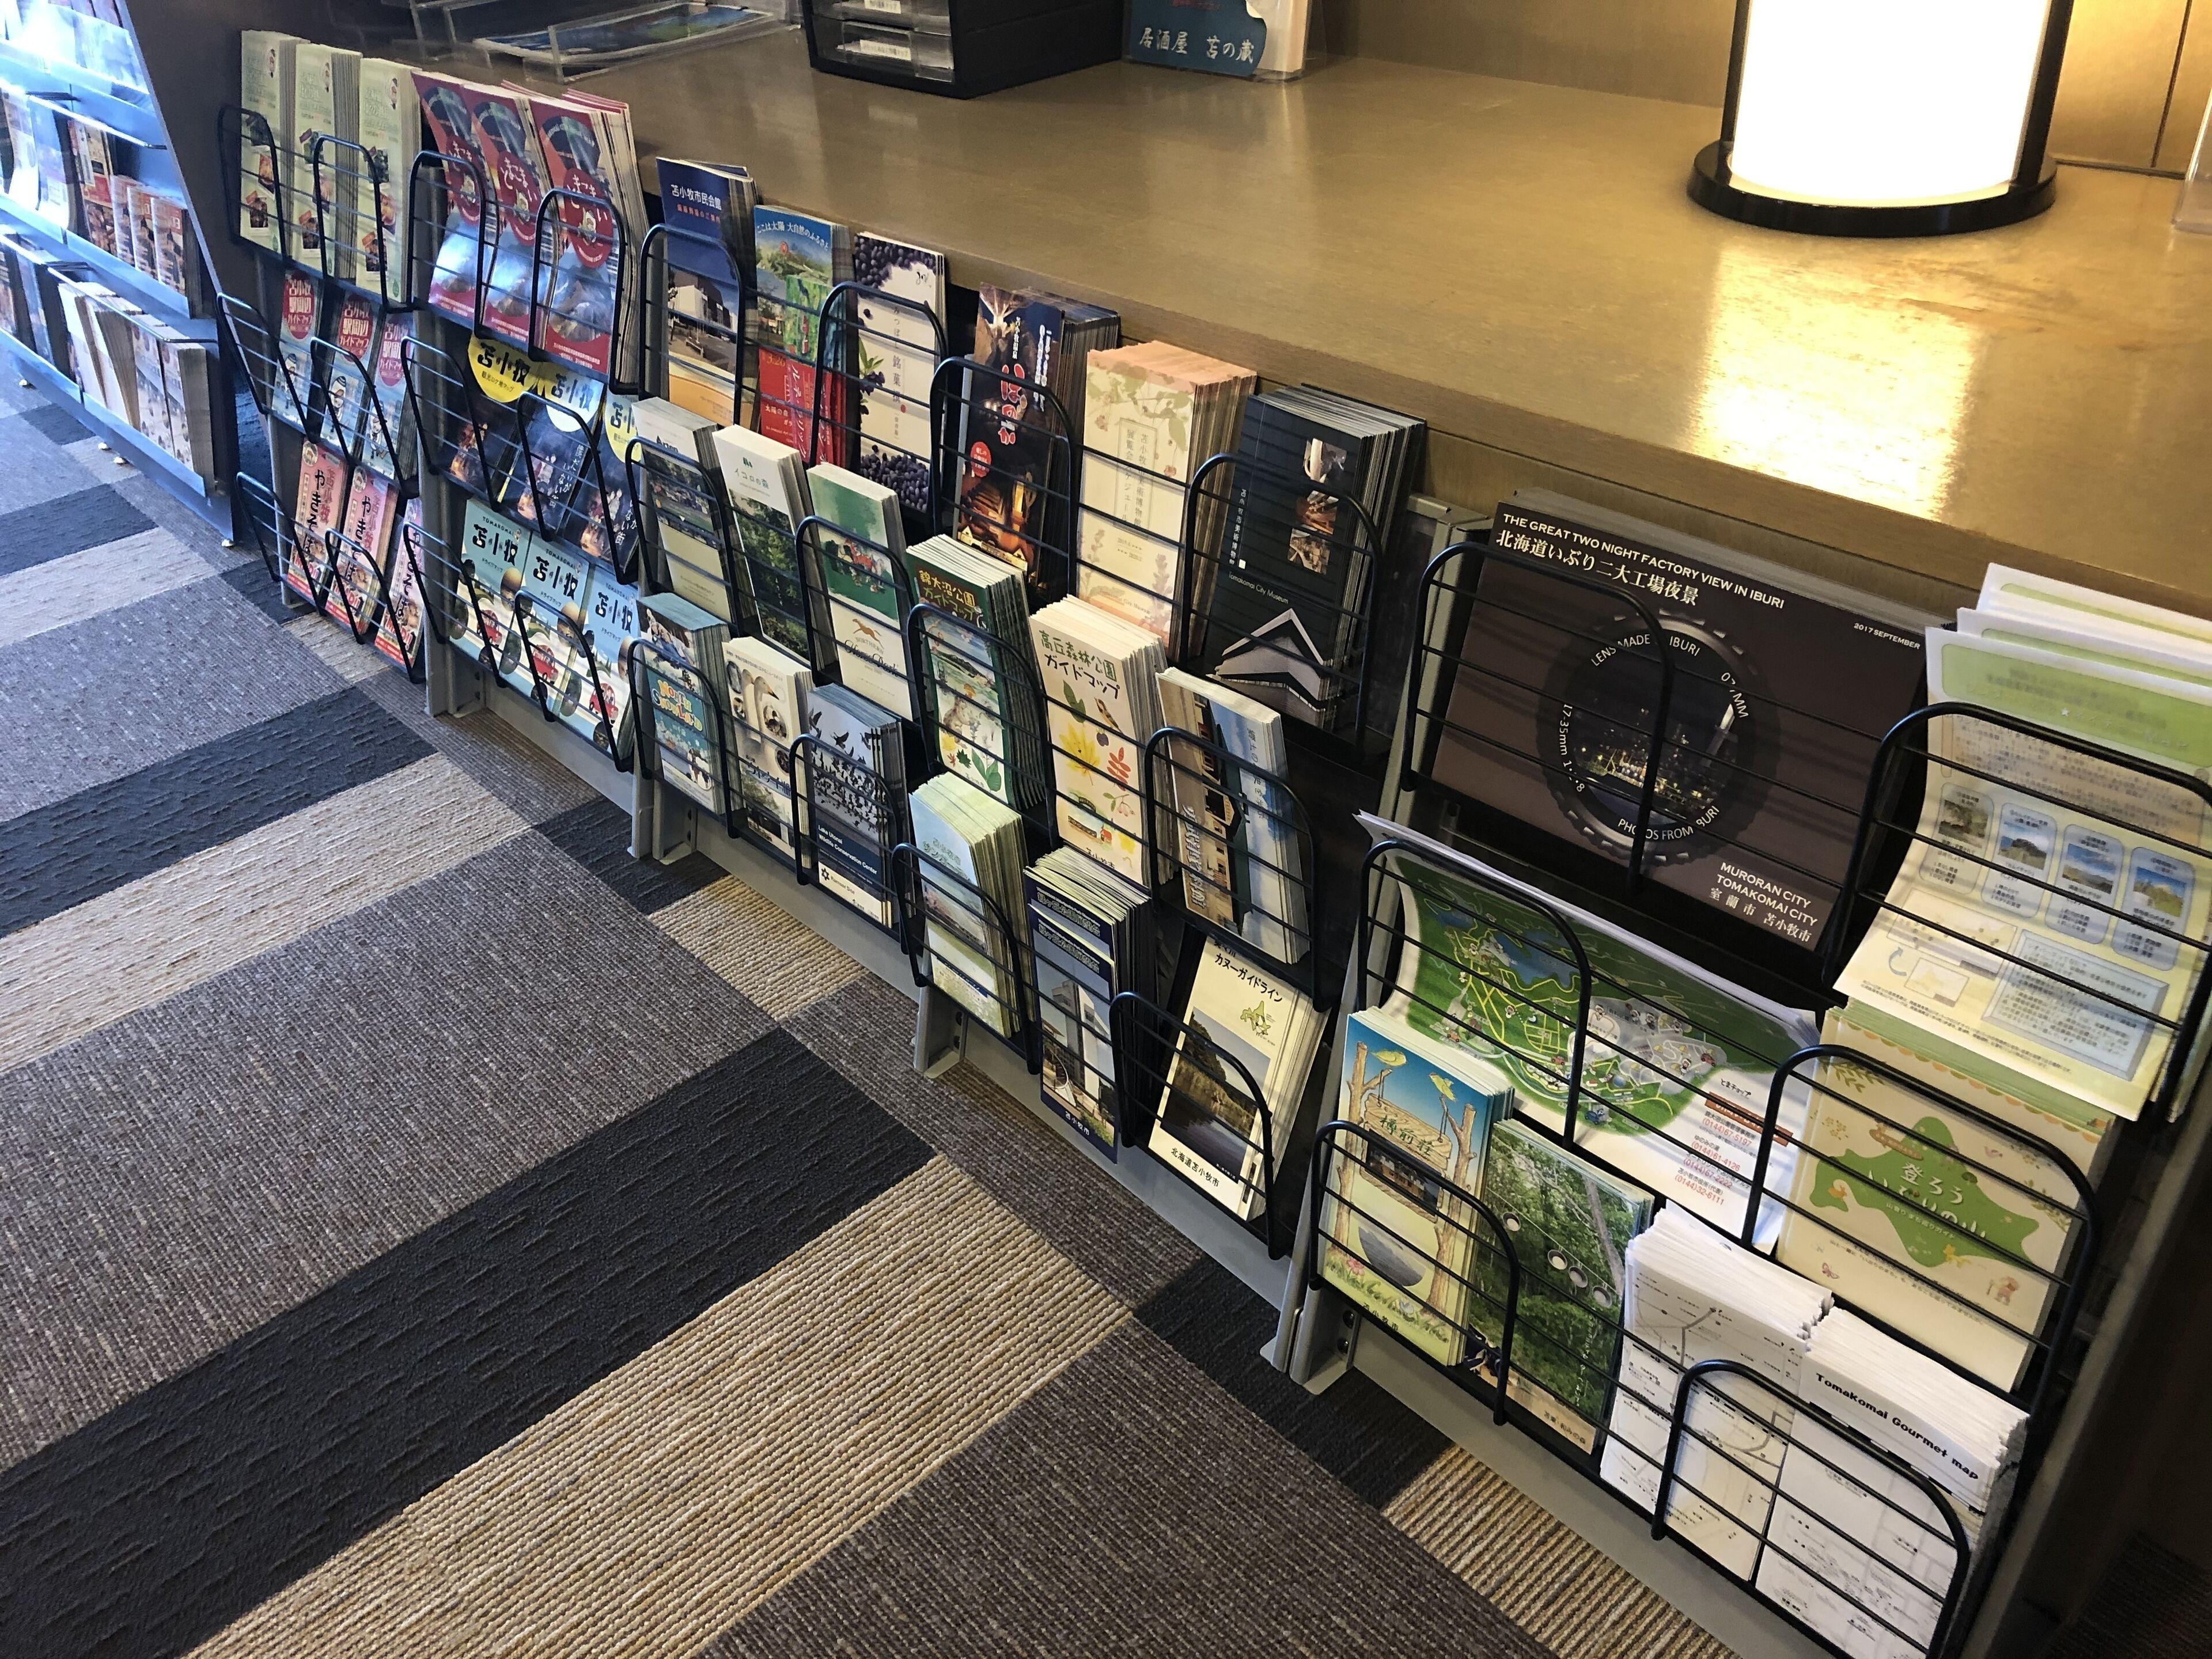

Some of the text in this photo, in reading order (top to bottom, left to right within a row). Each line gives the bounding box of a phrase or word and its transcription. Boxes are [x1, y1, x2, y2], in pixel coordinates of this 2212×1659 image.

[1139, 27, 1254, 64] 居酒屋 苫の蔵
[670, 184, 722, 211] 苫小牧市民会館
[472, 523, 518, 567] 苫小牧
[482, 516, 514, 536] TOMAKOMAI
[533, 555, 579, 601] 苫小牧
[1495, 529, 1699, 607] 北海道いぶり二大工場夜景
[1503, 513, 1785, 609] THE GREAT TWO NIGHT FACTORY VIEW IN IBURI
[1229, 571, 1290, 604] Tomakomai City Museum
[594, 591, 633, 634] 苫小牧
[1039, 628, 1118, 683] 高丘森林公園
[1590, 634, 1700, 666] LENS MADE IBURI
[1853, 622, 1921, 650] 2017 SEPTEMBER
[1044, 654, 1120, 700] ガイドマップ
[1558, 703, 1573, 756] 17-35mm
[1247, 727, 1266, 819] 郷土の史を学ぶ
[817, 824, 843, 844] Lake Utonai
[1618, 805, 1720, 840] PHOOS FROM BURI
[818, 833, 878, 876] Wildlife Conservation Center
[830, 874, 847, 890] Ramsar
[1716, 874, 1819, 927] TOMAKOMAI CITY
[1719, 862, 1812, 909] MURORAN CITY
[1708, 887, 1812, 943] 室蘭市 苫小牧市
[1214, 952, 1283, 1003] カヌーガイドライン
[1719, 1078, 1752, 1100] とまチョップ
[1702, 1117, 1753, 1147] (0144)67-5197
[1170, 1146, 1220, 1187] 北海道苫小牧市
[1683, 1157, 1734, 1190] (0144)67-2222
[1691, 1140, 1741, 1172] (0144)61-4126
[1674, 1174, 1725, 1206] (0144)32-6111
[1900, 1162, 1963, 1205] 登ろう
[1815, 1372, 1980, 1482] Tomakomai Gourmet map
